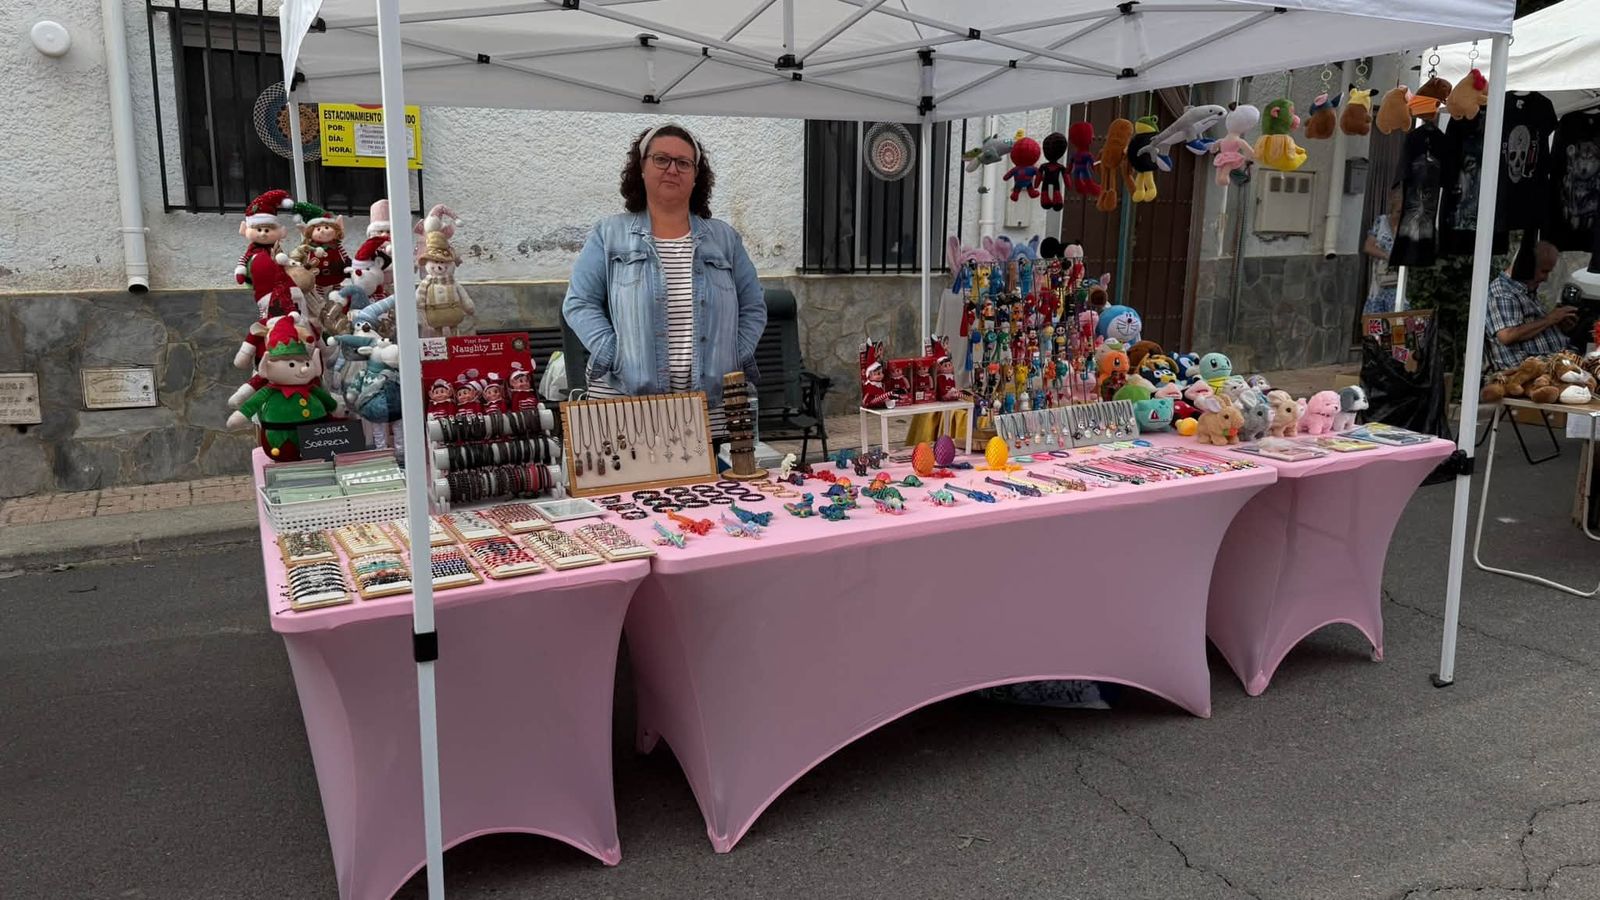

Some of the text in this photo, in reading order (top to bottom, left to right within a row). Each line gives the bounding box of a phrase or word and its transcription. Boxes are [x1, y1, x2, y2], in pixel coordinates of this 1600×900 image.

[323, 110, 382, 122] ESTACIONAMIENTO
[452, 343, 489, 354] Naughty
[492, 342, 504, 351] Elf
[314, 425, 348, 435] SOBRES
[304, 438, 350, 448] SORPRESA
